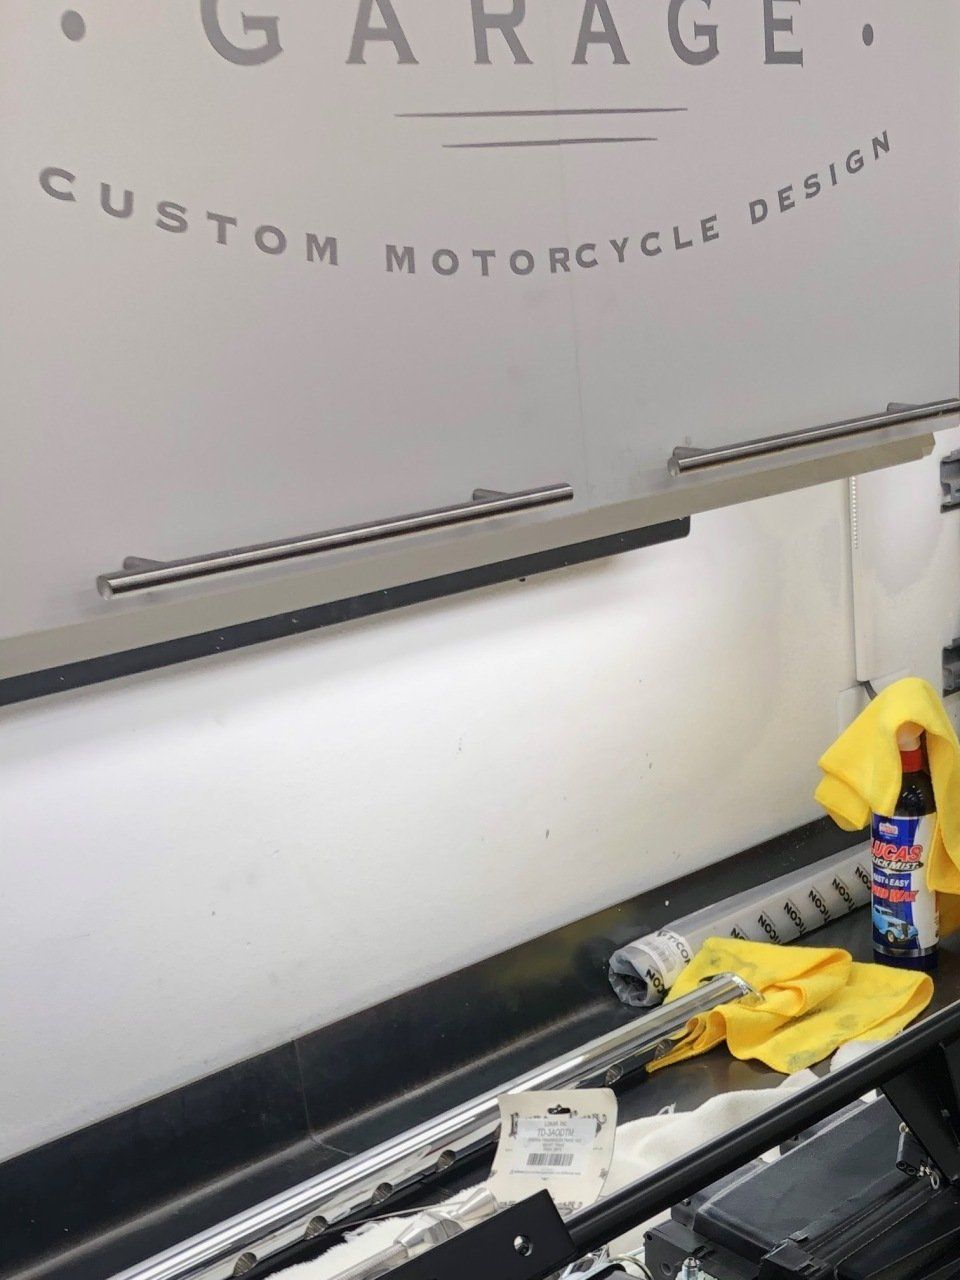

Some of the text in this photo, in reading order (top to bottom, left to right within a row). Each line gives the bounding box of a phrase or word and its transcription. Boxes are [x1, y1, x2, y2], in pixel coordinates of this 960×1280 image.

[200, 0, 804, 69] GARAGE
[38, 130, 892, 277] CUSTOM MOTORCYCLE DESIGN
[889, 878, 910, 888] EASY
